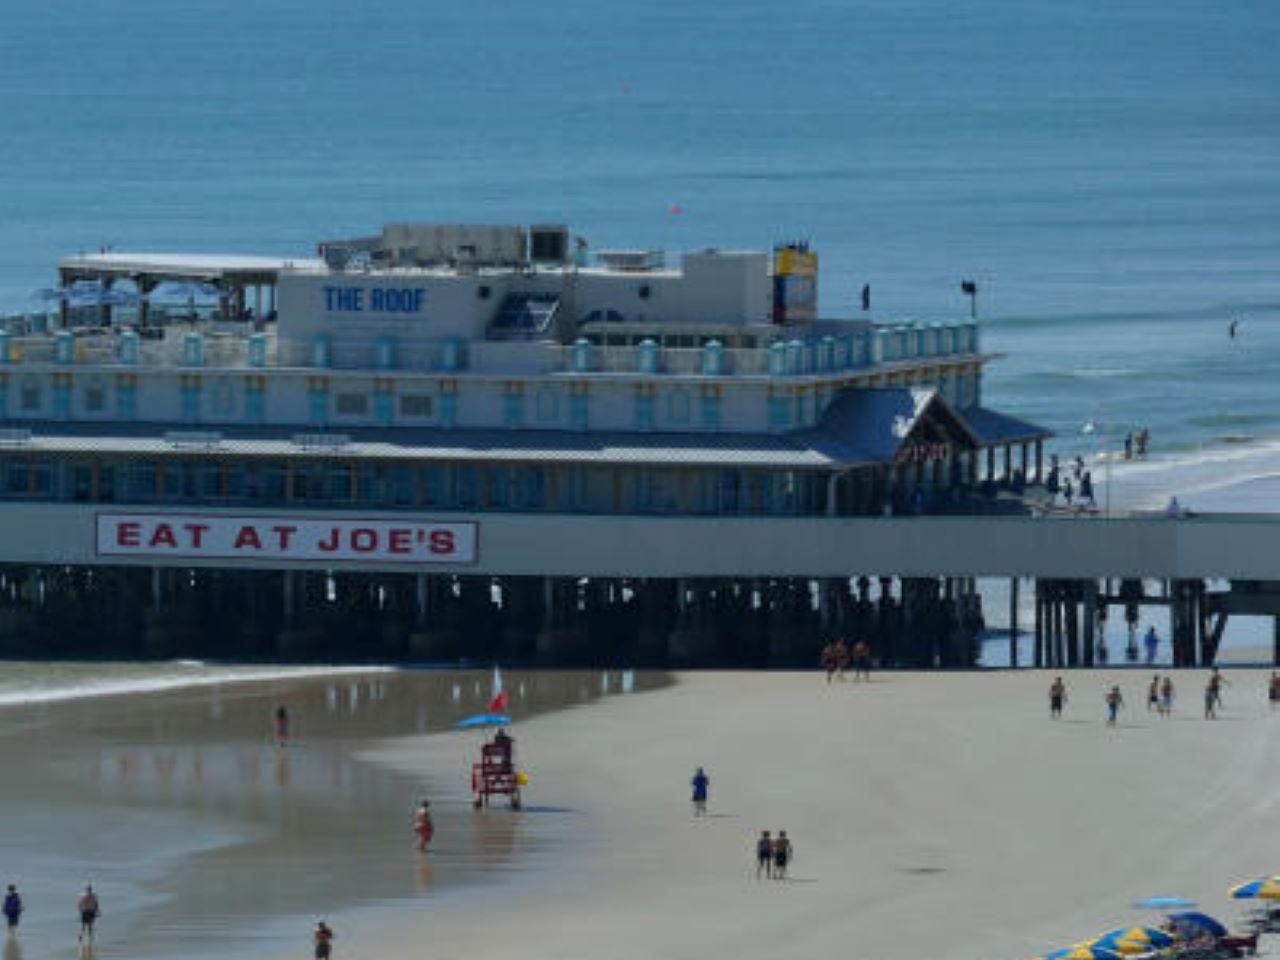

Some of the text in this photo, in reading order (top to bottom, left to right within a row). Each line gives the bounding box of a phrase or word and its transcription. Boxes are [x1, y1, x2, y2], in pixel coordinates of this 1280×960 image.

[325, 287, 426, 313] THE ROOF
[116, 522, 456, 554] EAT AT JOE'S
